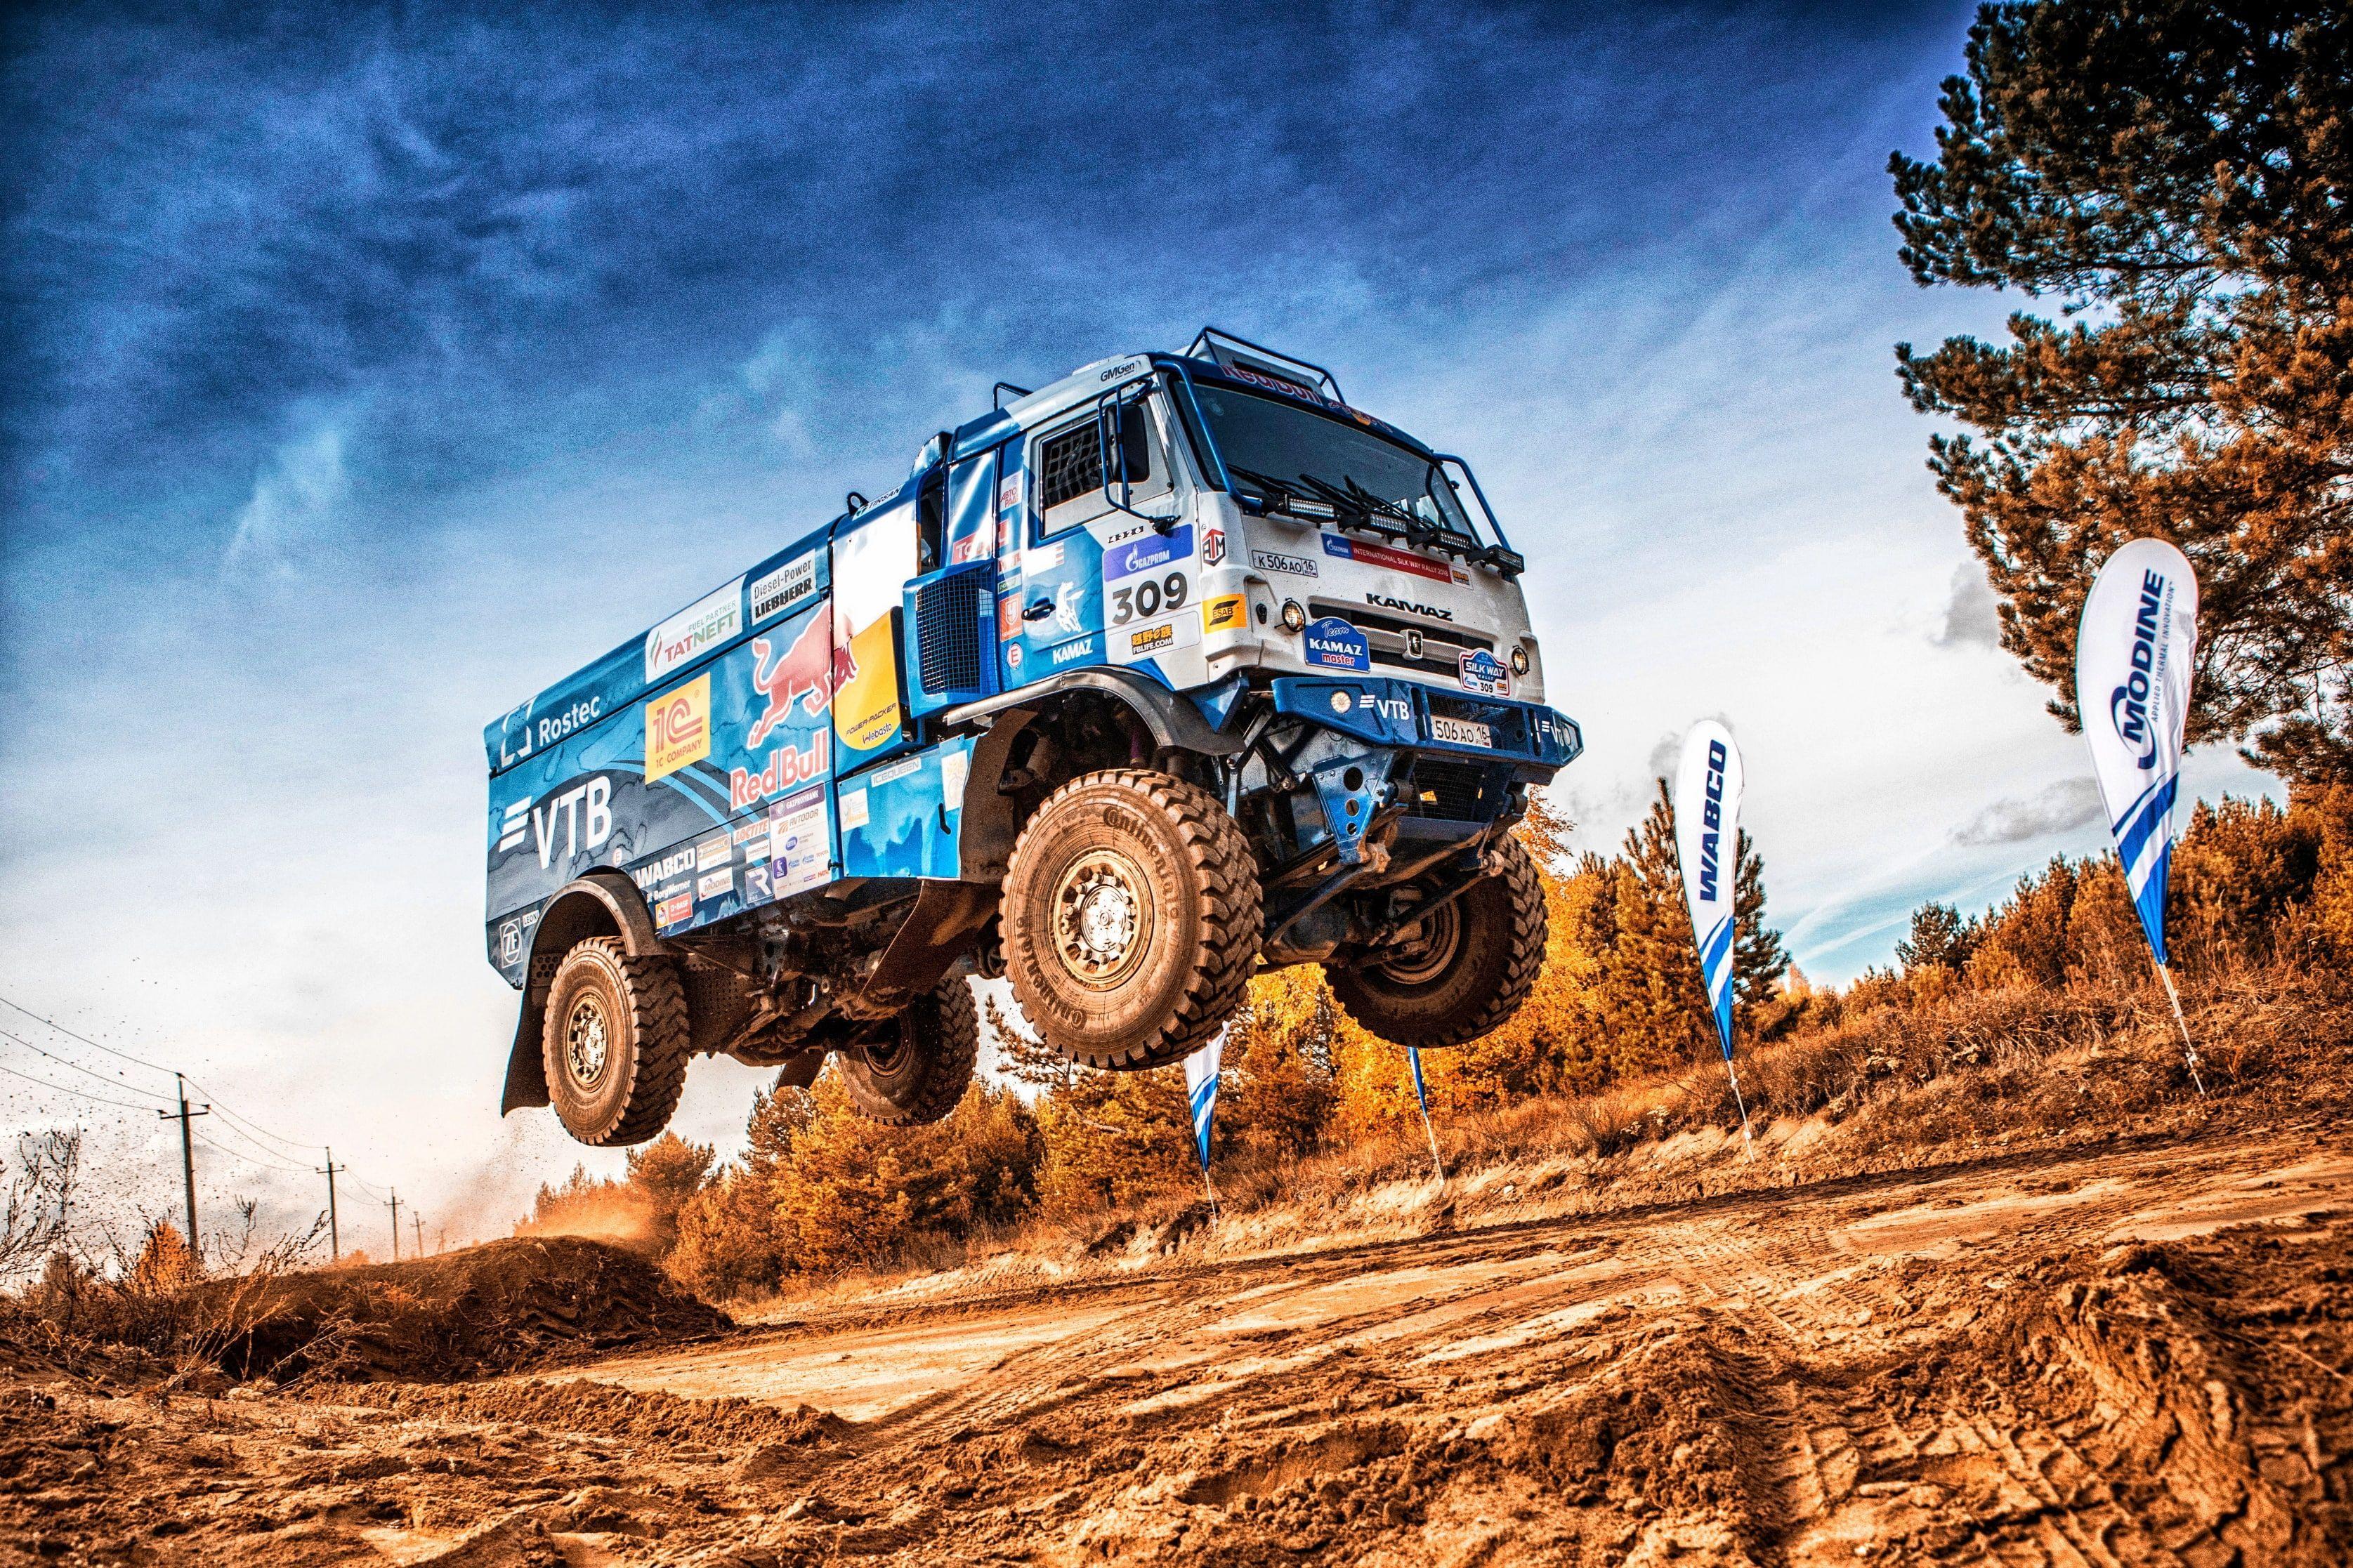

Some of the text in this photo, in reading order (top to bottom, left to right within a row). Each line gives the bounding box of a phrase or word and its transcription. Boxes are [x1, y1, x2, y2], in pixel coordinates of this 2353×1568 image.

[1101, 362, 1134, 382] GMGen
[1108, 526, 1143, 543] 4326
[1138, 550, 1169, 569] GAZPROM
[1304, 560, 1313, 571] 16
[1354, 548, 1396, 563] INTERNATIONAL
[1397, 558, 1410, 567] SILK
[1422, 563, 1437, 573] RALLY
[754, 559, 812, 599] Diesel-Power
[755, 577, 813, 619] LIEBHERR
[1112, 572, 1188, 625] 309
[1366, 593, 1453, 621] KAMAZ
[688, 600, 736, 631] FUEL PARTNER
[1212, 607, 1233, 618] ESAB
[664, 610, 736, 663] TATNEFT
[1321, 620, 1349, 638] Team
[1054, 638, 1094, 664] KAMAZ
[1132, 638, 1173, 655] FBLIFE.COM
[1309, 638, 1363, 657] KAMAZ
[2123, 567, 2165, 744] MODINE
[1322, 653, 1355, 666] master
[1465, 661, 1486, 674] SILK
[1486, 666, 1505, 678] WAY
[2155, 642, 2169, 681] THERMAL
[1480, 683, 1493, 693] 309
[1377, 699, 1410, 720] VTB
[2153, 685, 2162, 723] APPLIED
[539, 696, 601, 747] Rostec
[846, 702, 896, 737] POWER-PACKER
[862, 722, 892, 744] Webasto
[1477, 726, 1487, 739] 16
[656, 739, 702, 768] 1C COMPANY
[786, 790, 819, 808] GAZPROMBANK
[532, 776, 612, 869] VTB
[735, 819, 768, 841] LOCTITE
[1700, 739, 1727, 902] WABCO
[635, 848, 695, 889] WABCO
[704, 876, 731, 893] MODINE
